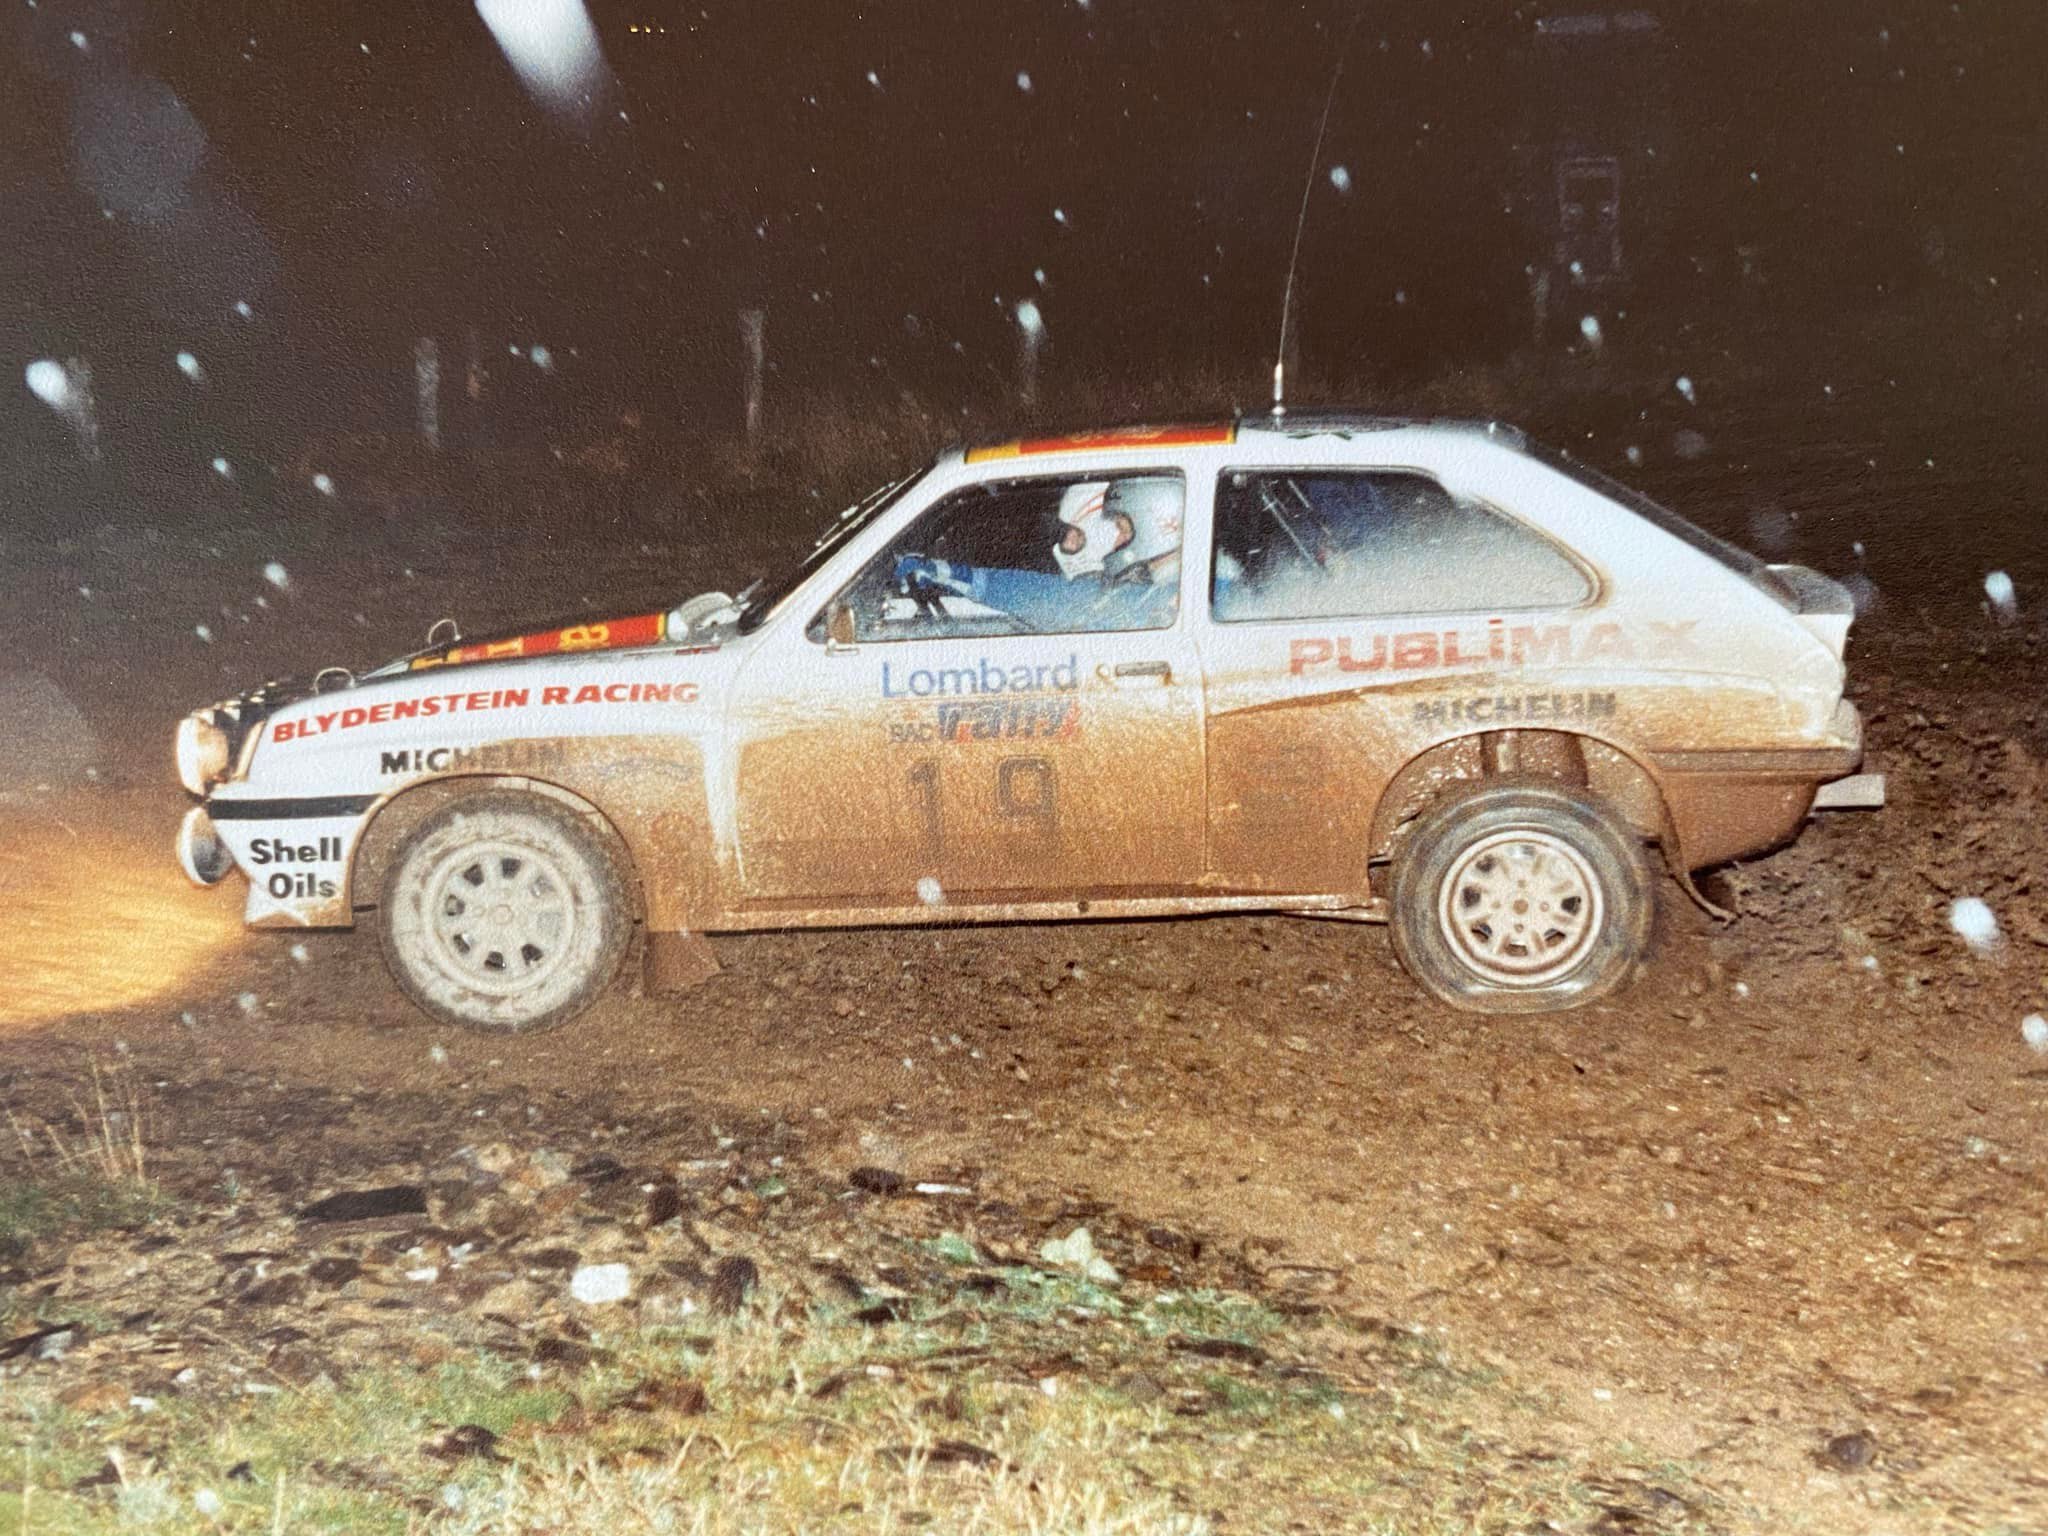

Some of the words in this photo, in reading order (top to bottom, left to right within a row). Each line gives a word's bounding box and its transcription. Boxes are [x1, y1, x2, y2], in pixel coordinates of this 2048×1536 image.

[882, 655, 1076, 697] Lombard
[273, 689, 530, 743] BLYDENSTEIN
[541, 682, 699, 705] RACING
[1413, 692, 1616, 724] MICHELIN
[250, 837, 342, 863] Shell
[268, 872, 336, 898] Oils
